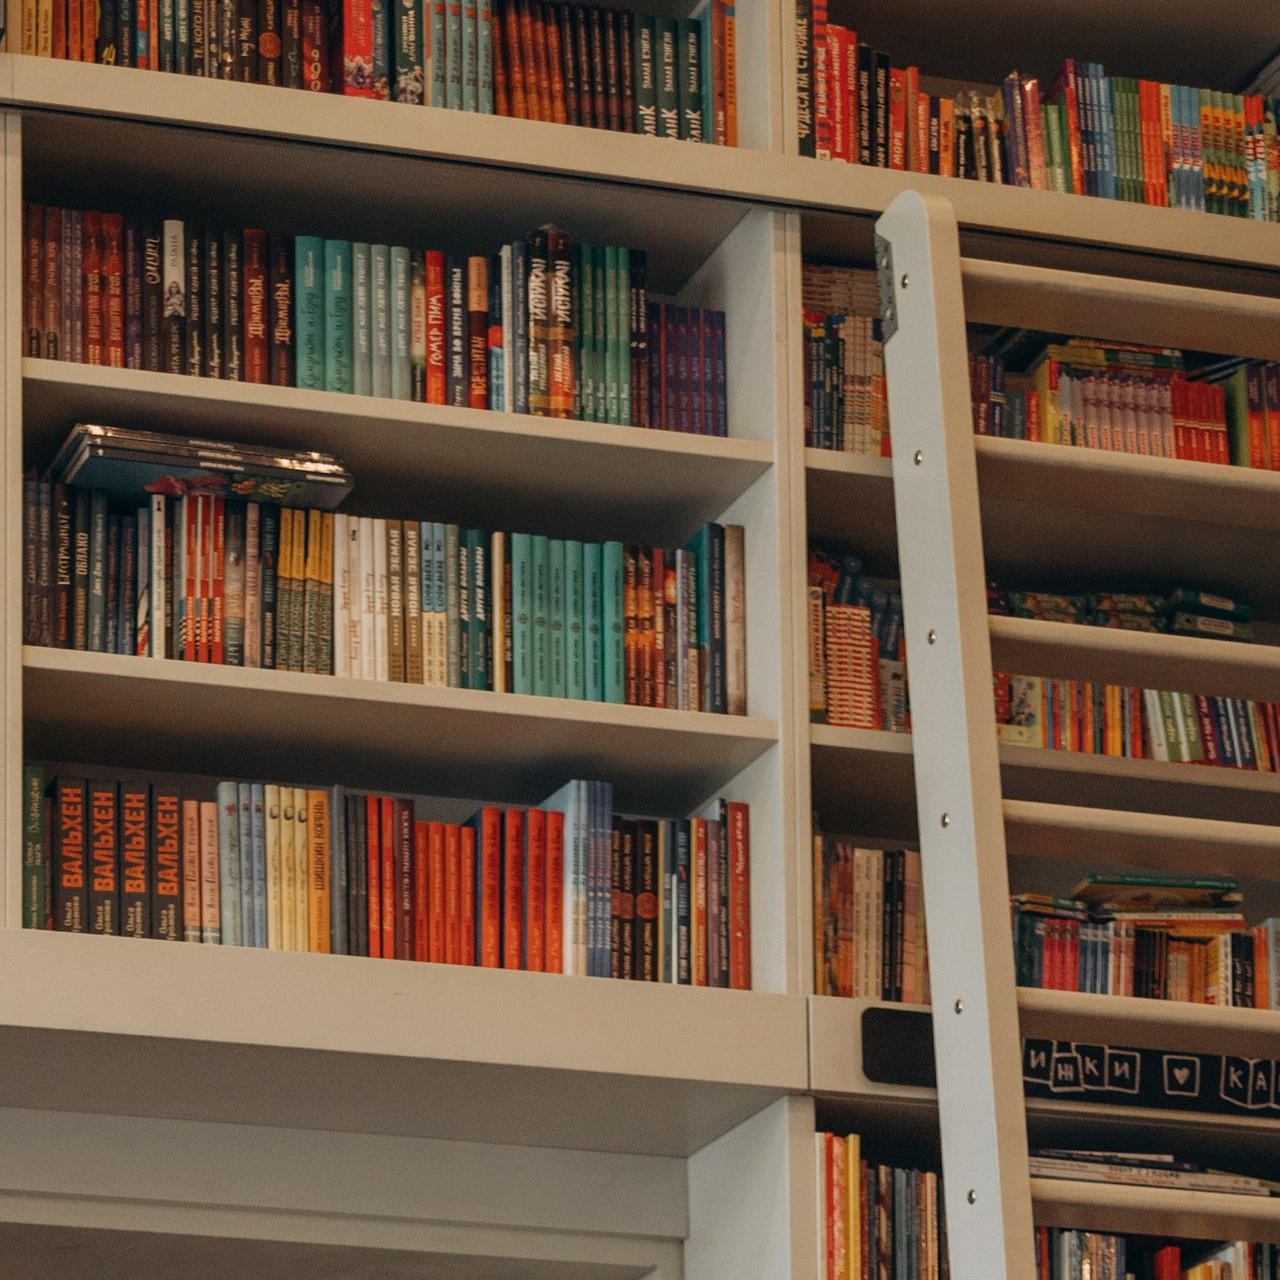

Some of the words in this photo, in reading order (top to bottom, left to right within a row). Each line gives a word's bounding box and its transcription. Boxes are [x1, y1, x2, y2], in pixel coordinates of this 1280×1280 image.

[796, 15, 809, 71] СТРОЙКЕ
[798, 73, 808, 89] НА
[847, 43, 855, 91] КОЛОБОК
[797, 93, 808, 140] ЧУДЕСА
[893, 131, 903, 164] МОРЕ
[428, 294, 443, 324] ПИМ
[429, 326, 443, 366] ГОМЕР
[76, 533, 88, 575] ОБЛАКО
[390, 529, 401, 576] ЗЕМЛЯ
[391, 580, 401, 617] НОВАЯ
[61, 787, 83, 888] ВАЛЬХЕН
[94, 792, 114, 892] ВАЛЬХЕН
[125, 794, 145, 893] ВАЛЬХЕН
[158, 797, 178, 896] ВАЛЬХЕН
